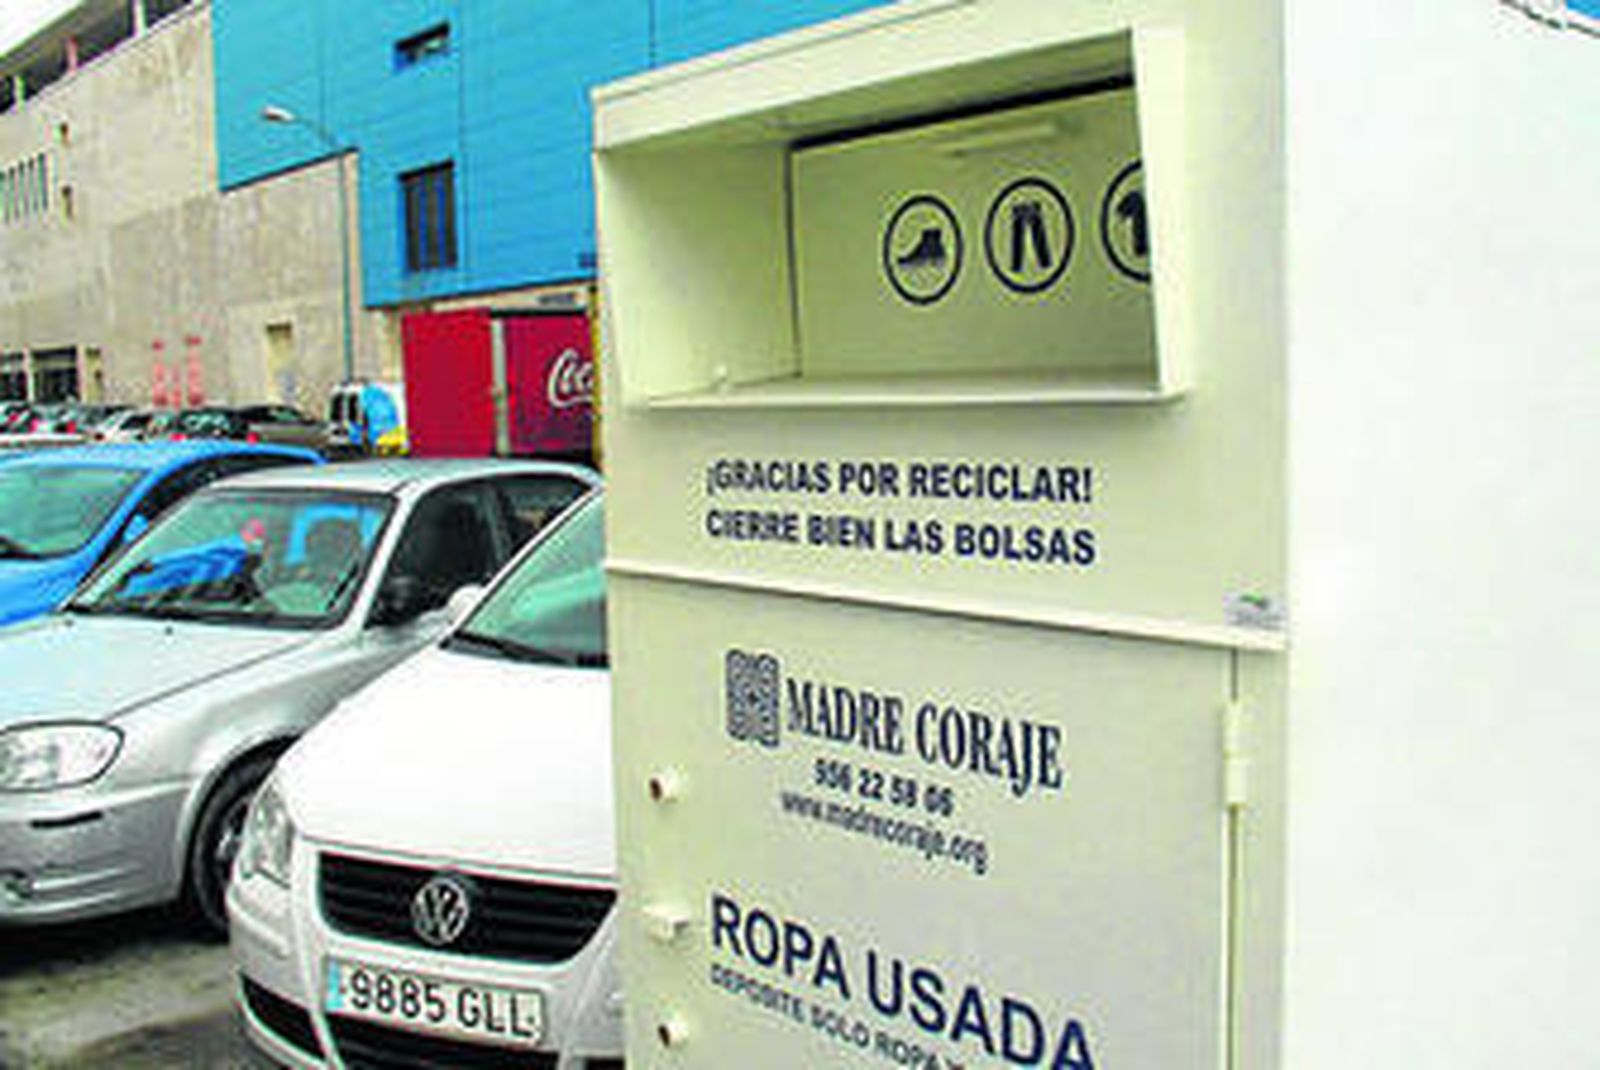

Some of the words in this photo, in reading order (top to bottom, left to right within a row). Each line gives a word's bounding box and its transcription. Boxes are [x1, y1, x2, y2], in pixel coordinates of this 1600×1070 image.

[707, 460, 831, 497] ¡GRACIAS
[839, 463, 899, 496] POR
[909, 464, 1092, 503] RECICLAR!
[706, 510, 800, 543] CIERRE
[808, 514, 876, 549] BIEN
[885, 519, 944, 555] LAS
[955, 524, 1096, 565] BOLSAS
[786, 678, 904, 755] MADRE
[915, 702, 1063, 797] CORAJE
[858, 769, 885, 800] 22
[890, 775, 918, 808] 58
[781, 790, 987, 875] www.madrecoraje.org
[351, 969, 446, 1023] 9885
[457, 987, 535, 1038] GLL
[711, 895, 851, 1000] ROPA
[867, 950, 1096, 1070] USADA
[711, 963, 805, 1023] DEPOSITE
